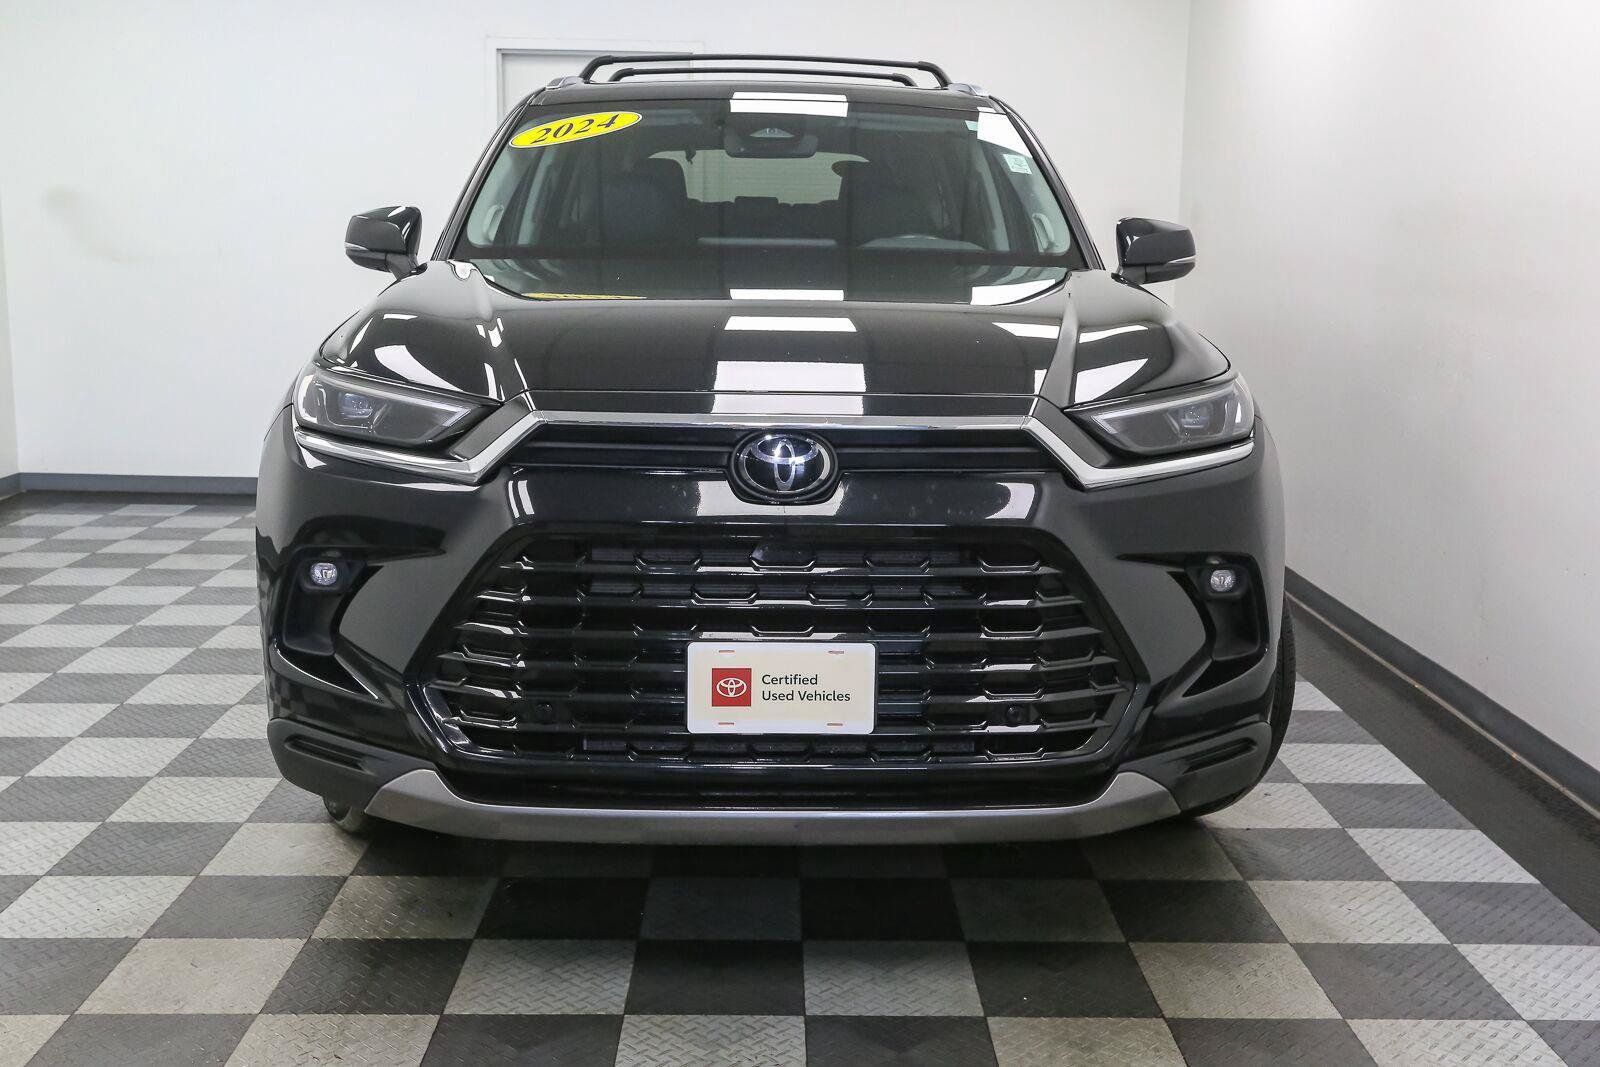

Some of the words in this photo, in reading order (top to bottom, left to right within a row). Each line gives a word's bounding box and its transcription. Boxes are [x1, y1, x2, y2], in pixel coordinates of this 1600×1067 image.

[530, 113, 620, 144] 2024
[761, 674, 818, 685] Certified
[761, 690, 794, 702] Used
[798, 690, 851, 702] Vehicles
